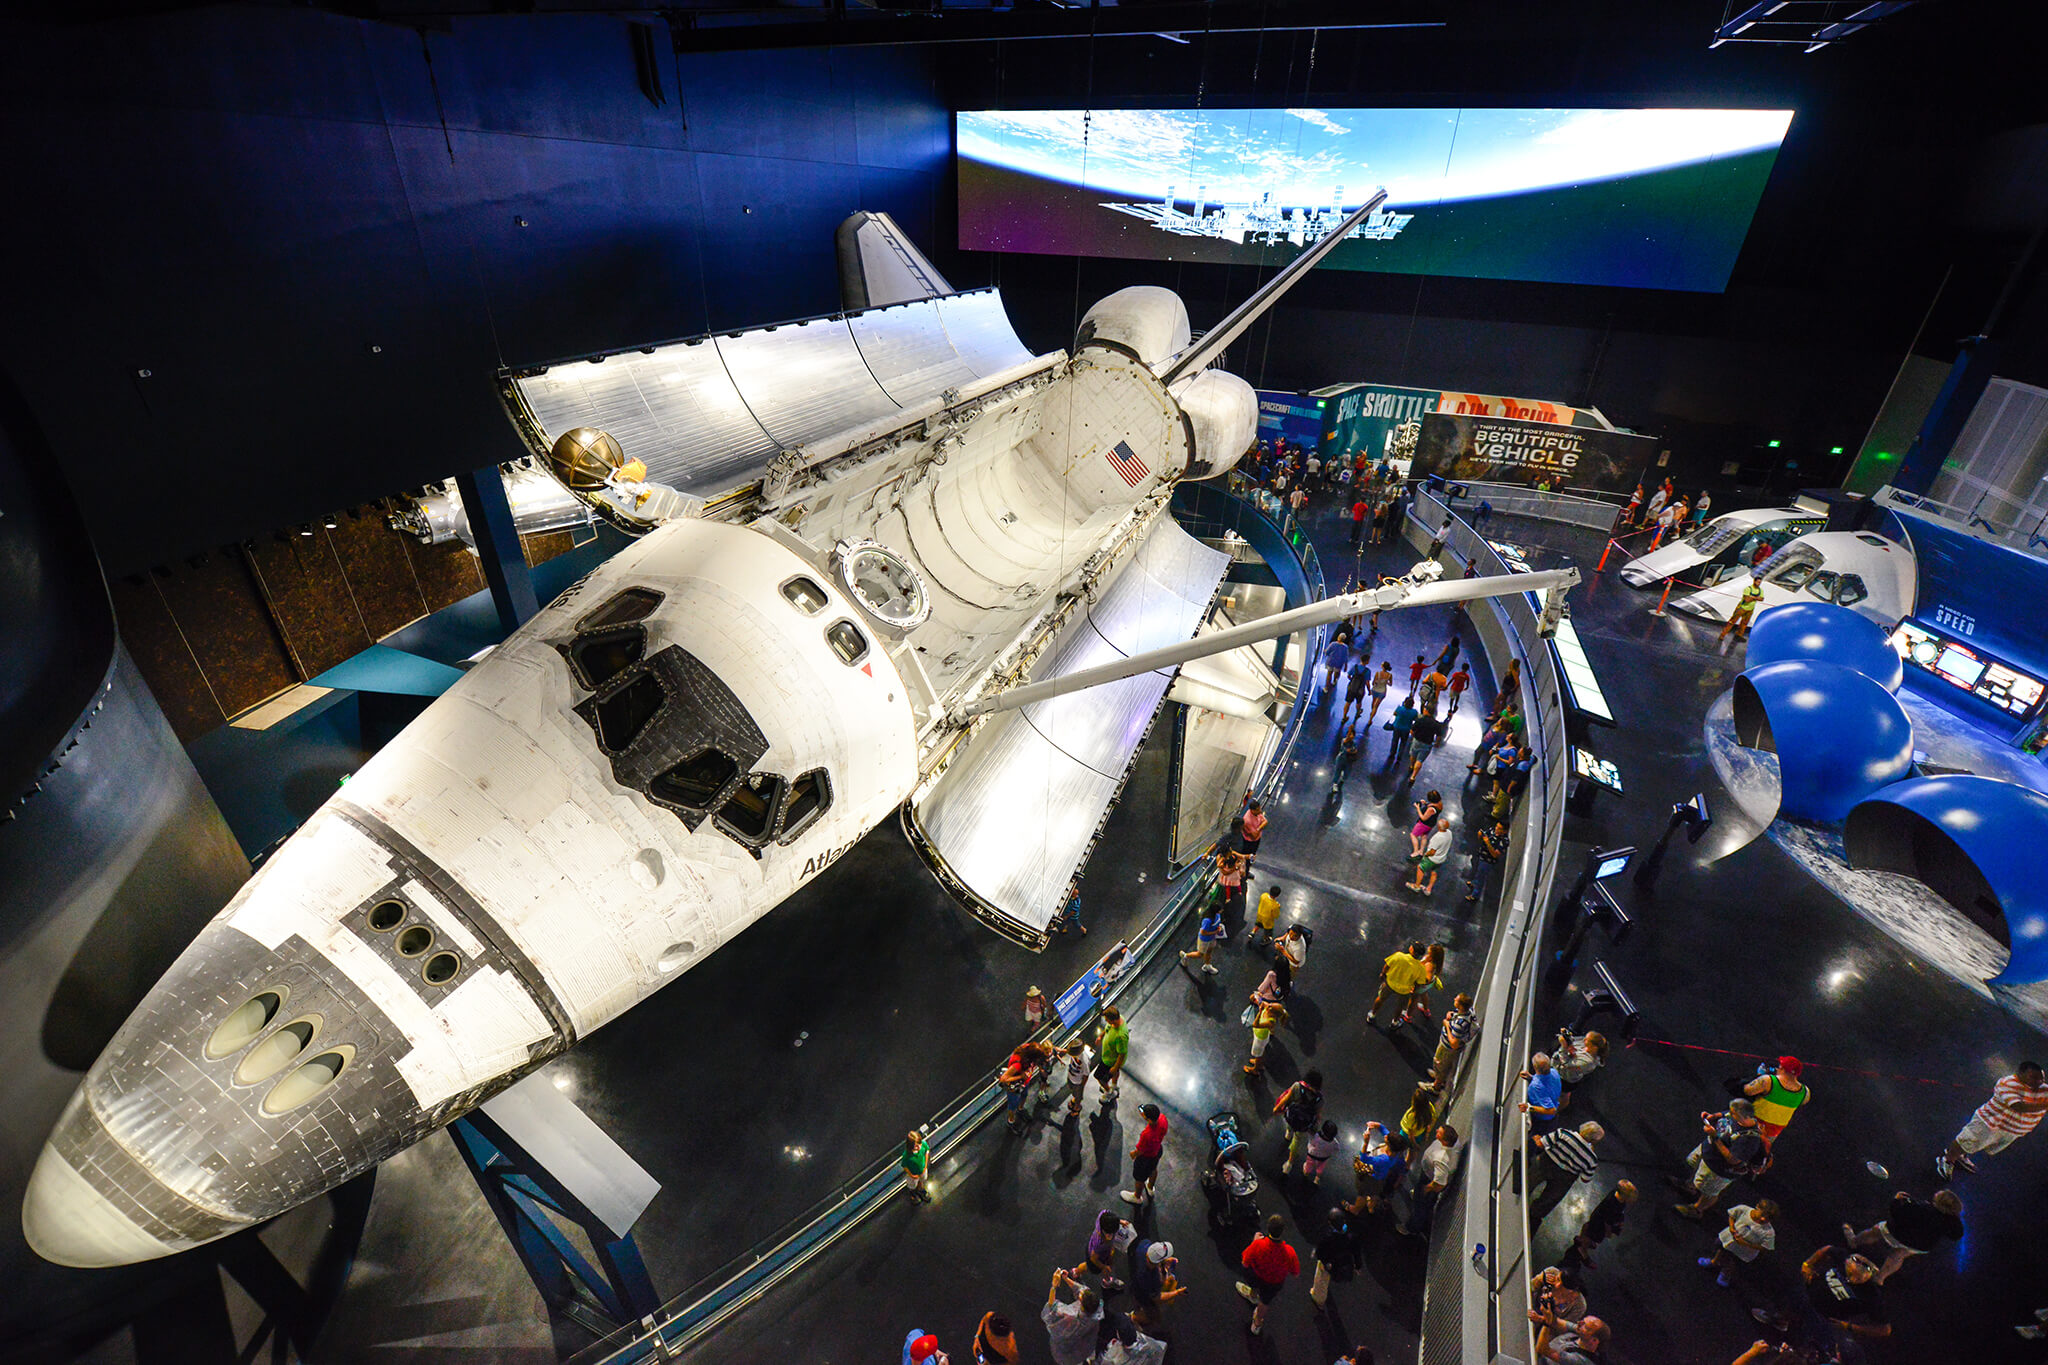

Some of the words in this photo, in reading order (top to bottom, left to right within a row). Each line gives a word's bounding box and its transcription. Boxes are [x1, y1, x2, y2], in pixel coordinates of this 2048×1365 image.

[1337, 393, 1361, 424] SPACE
[1362, 392, 1436, 422] SHUTTLE
[1473, 442, 1579, 467] VEHICLE
[1475, 430, 1583, 453] BEAUTIFUL
[1936, 609, 1975, 636] SPEED
